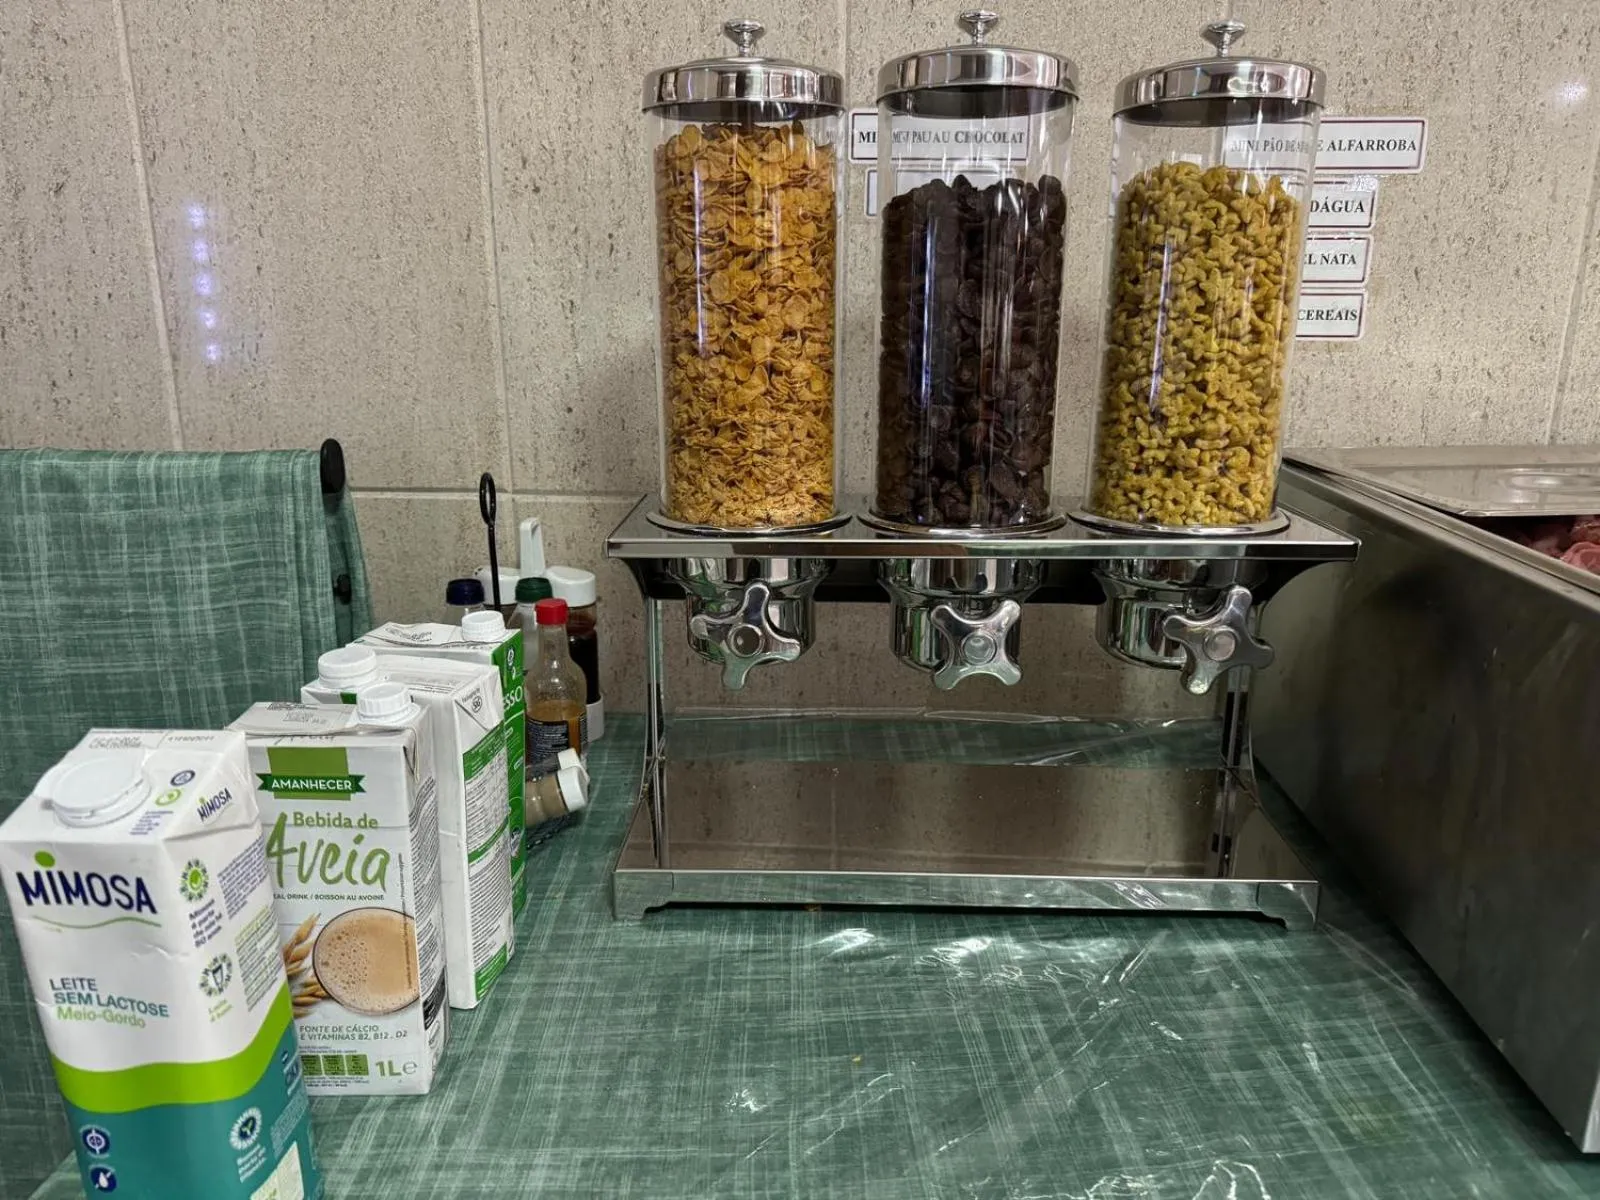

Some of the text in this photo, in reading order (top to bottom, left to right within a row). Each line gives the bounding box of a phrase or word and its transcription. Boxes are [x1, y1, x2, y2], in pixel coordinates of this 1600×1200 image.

[1327, 138, 1417, 152] ALFARROBA
[1320, 253, 1357, 265] NATA
[1297, 309, 1358, 321] CEREAIS
[271, 778, 352, 791] AMANHECER
[196, 786, 232, 821] MIMOSA
[292, 811, 378, 829] Bebida de
[265, 811, 387, 893] Aveia
[16, 851, 158, 914] MIMOSA
[50, 977, 97, 992] LEITE
[54, 992, 170, 1018] SEM LACTOSE
[57, 1006, 146, 1029] Meio-Gordo
[299, 1024, 380, 1033] FONTE DE CÁLCIO
[308, 1033, 356, 1041] VITAMINAS
